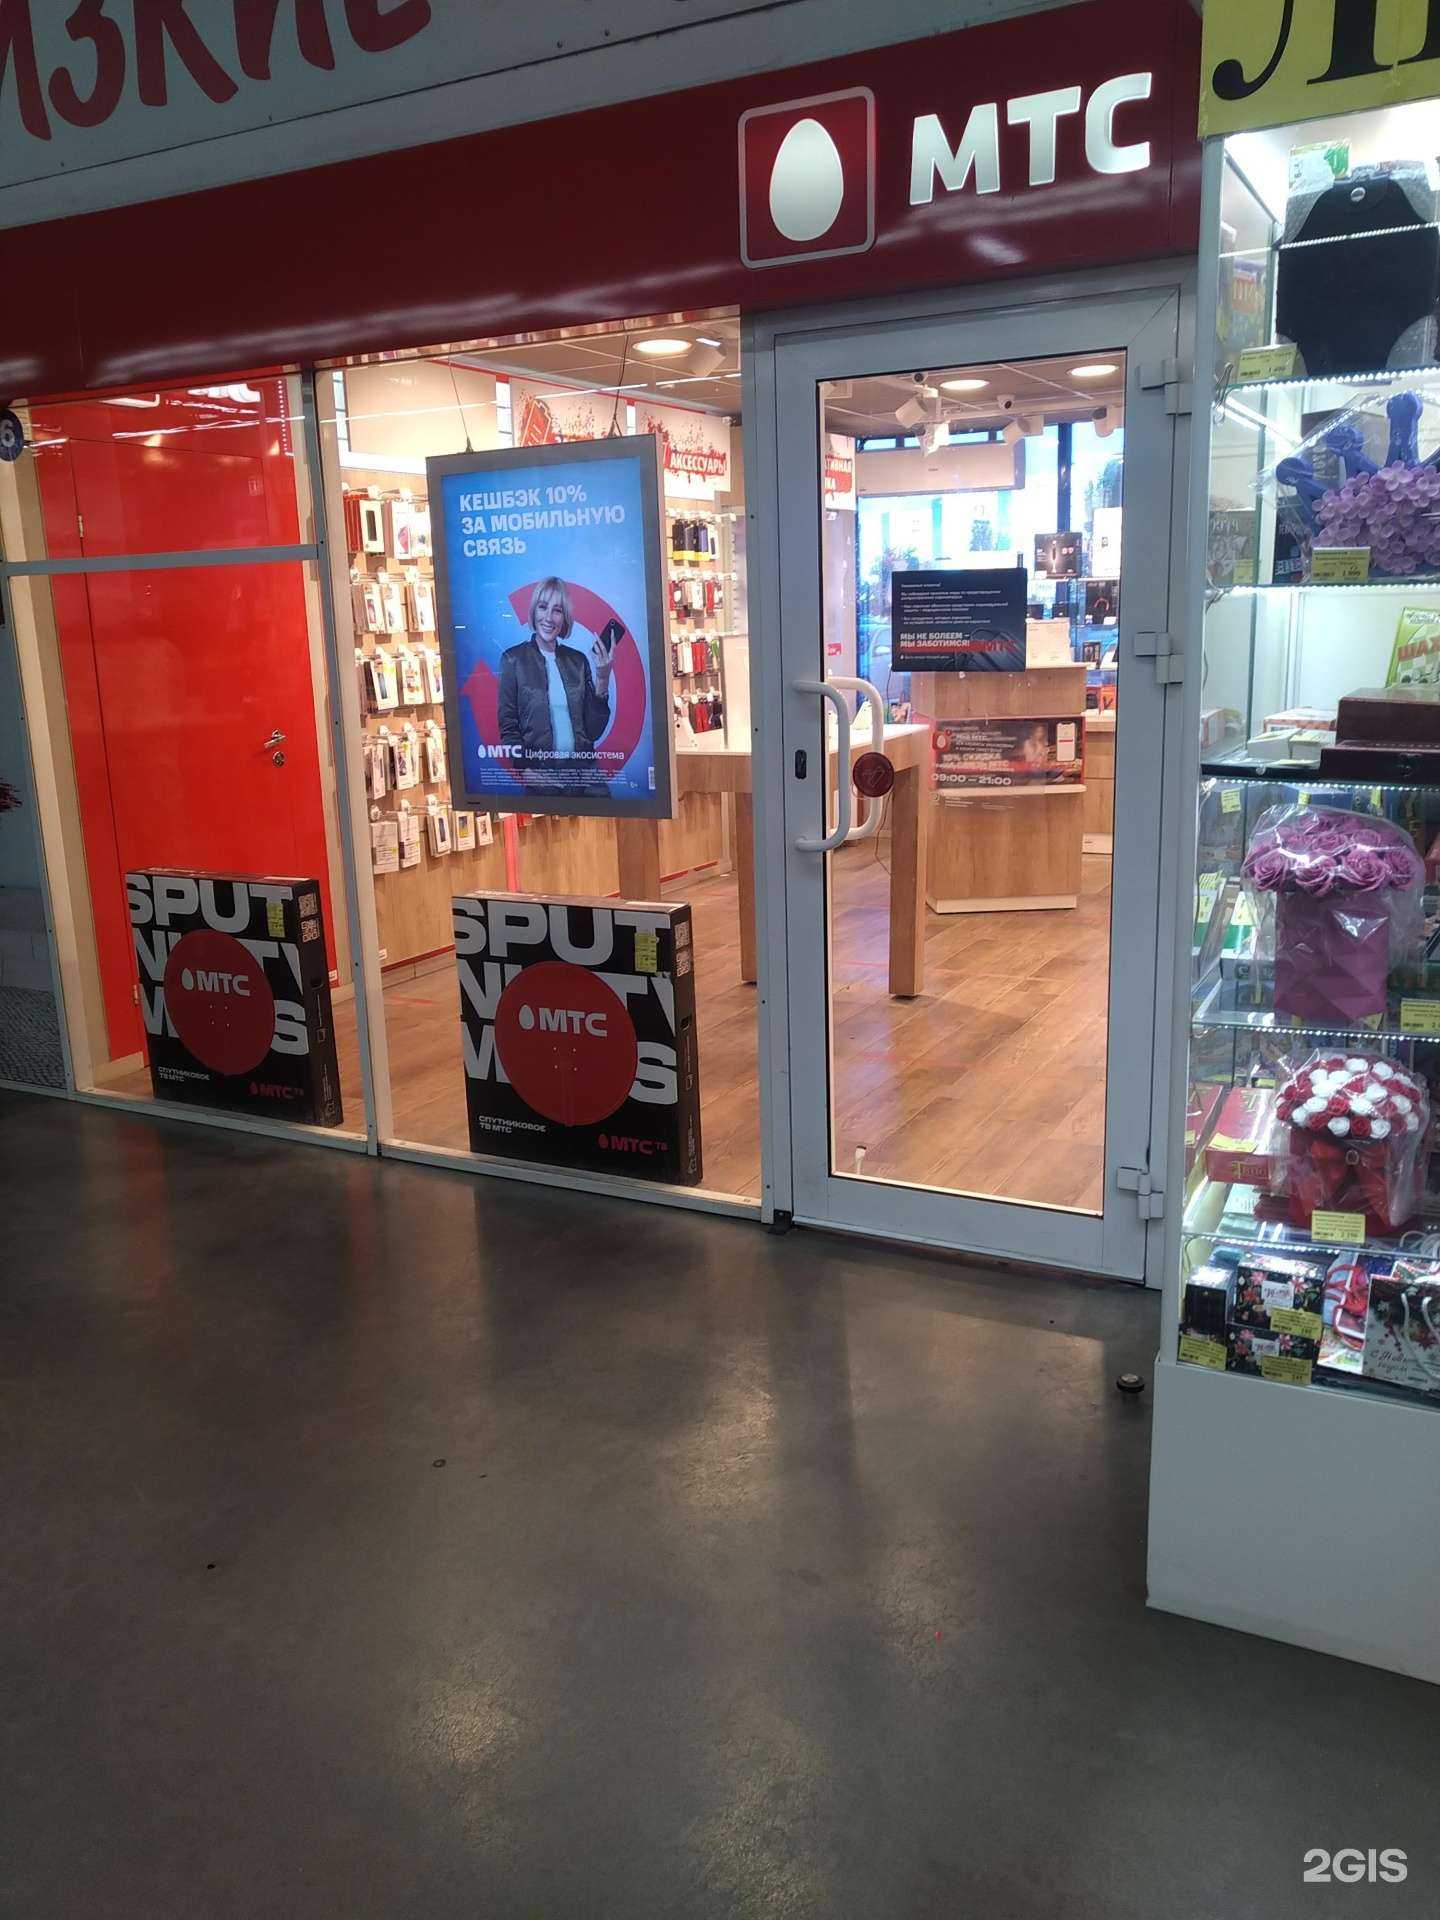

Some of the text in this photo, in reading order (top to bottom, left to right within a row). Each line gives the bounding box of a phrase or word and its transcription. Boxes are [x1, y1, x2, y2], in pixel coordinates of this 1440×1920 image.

[909, 72, 1152, 205] МТС
[459, 484, 587, 512] КЕШБЭК 10%
[461, 505, 625, 535] ЗА МОБИЛЬНУЮ
[463, 536, 526, 557] СВЯЗЬ
[916, 639, 970, 647] ЗАБОТИМСЯ!
[928, 632, 962, 640] БОЛЕЕМ
[488, 744, 625, 760] МТС Цифровая экосистема
[197, 970, 250, 996] МТС
[539, 1008, 607, 1037] МТС
[260, 1084, 293, 1099] МТС
[478, 1115, 546, 1132] СПУТНИКОВОЕ
[479, 1123, 512, 1134] ТВ МТС
[610, 1135, 654, 1154] МТС
